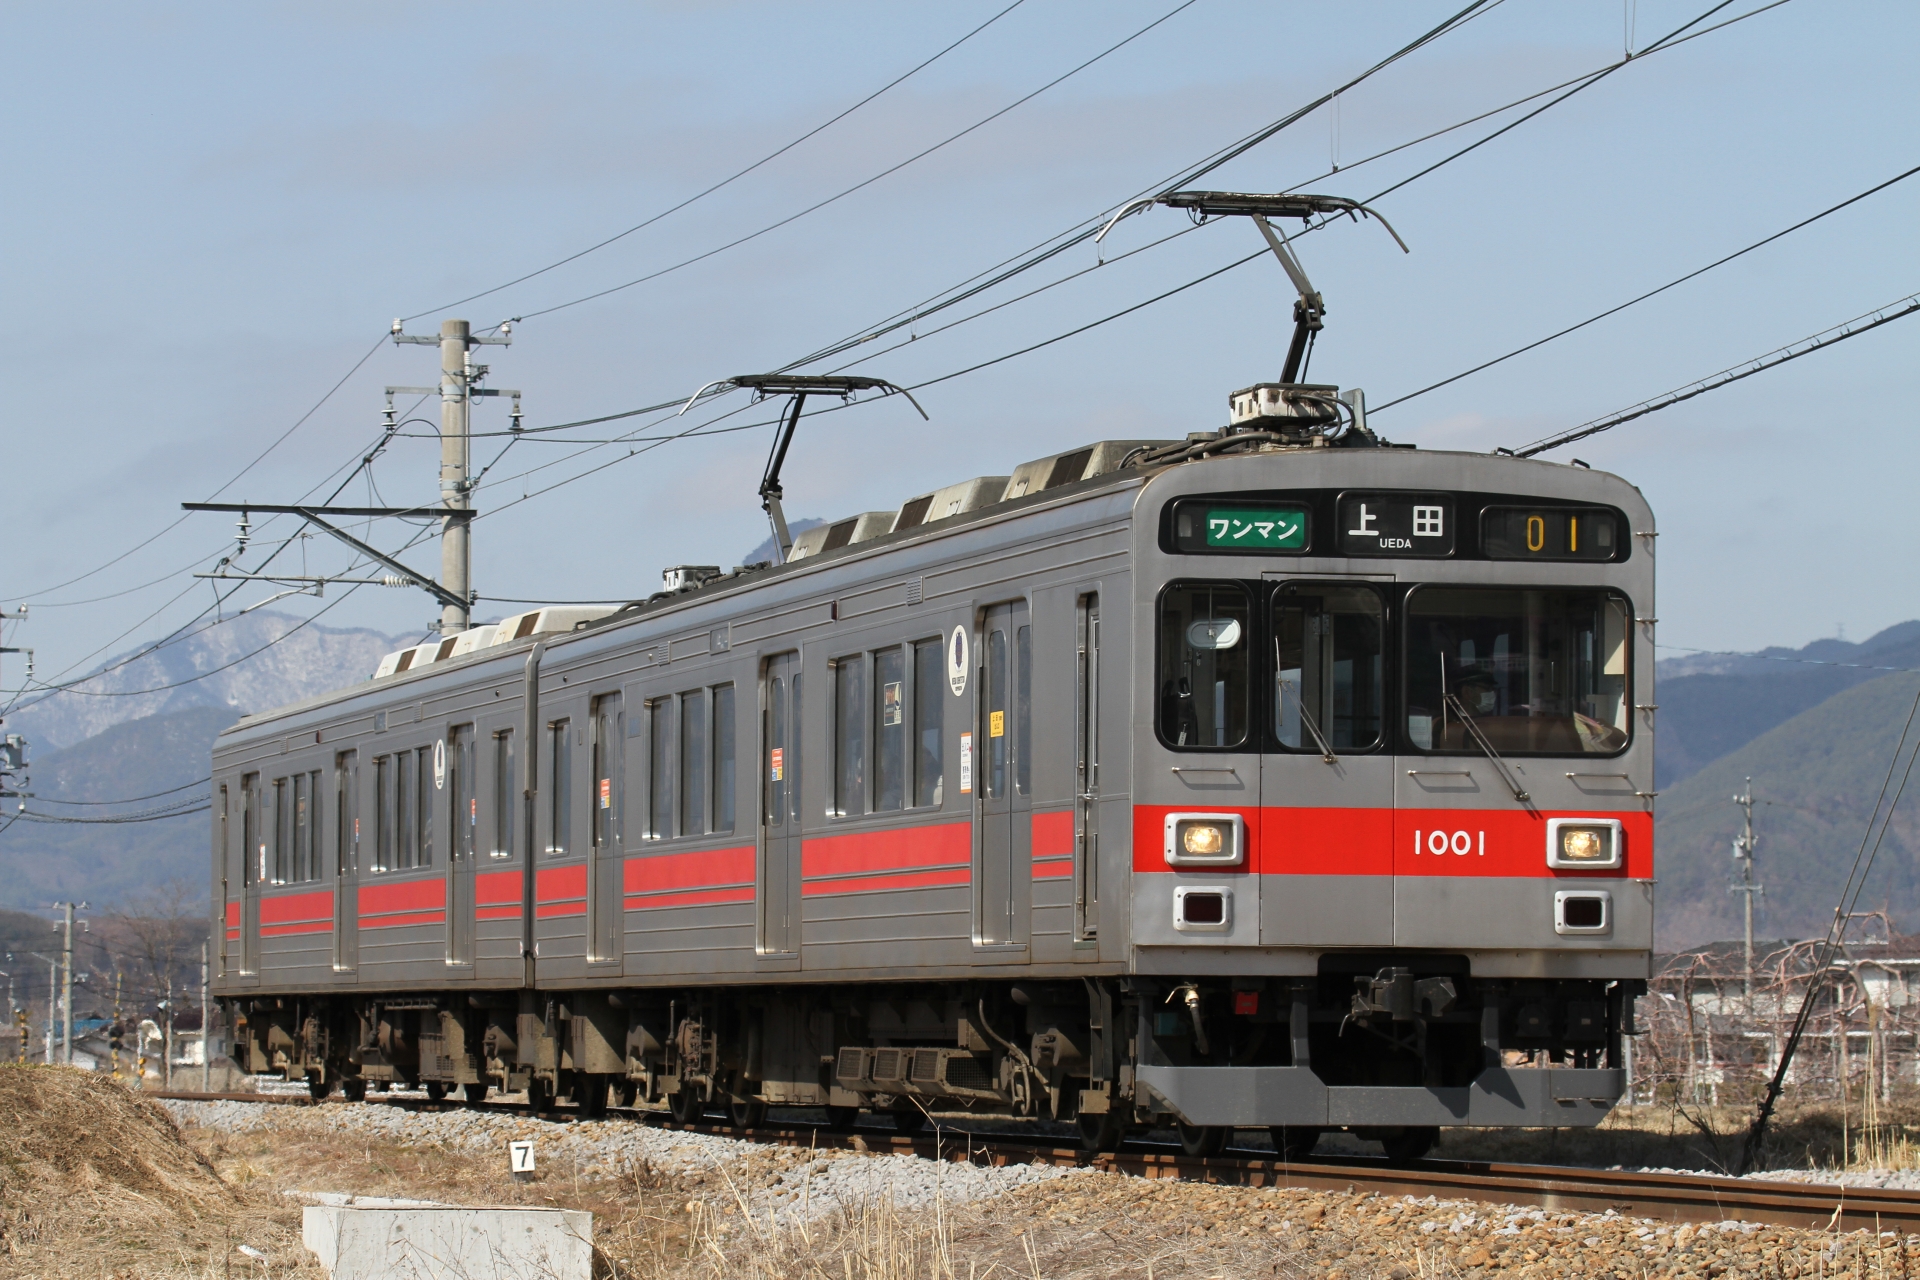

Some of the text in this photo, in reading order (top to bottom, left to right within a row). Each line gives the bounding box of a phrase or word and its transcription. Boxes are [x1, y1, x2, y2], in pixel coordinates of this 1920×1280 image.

[1209, 519, 1298, 540] ワンマン
[1348, 503, 1443, 537] 上田
[1379, 538, 1412, 549] UEDA
[1415, 829, 1485, 856] 1001
[515, 1145, 530, 1168] 7
